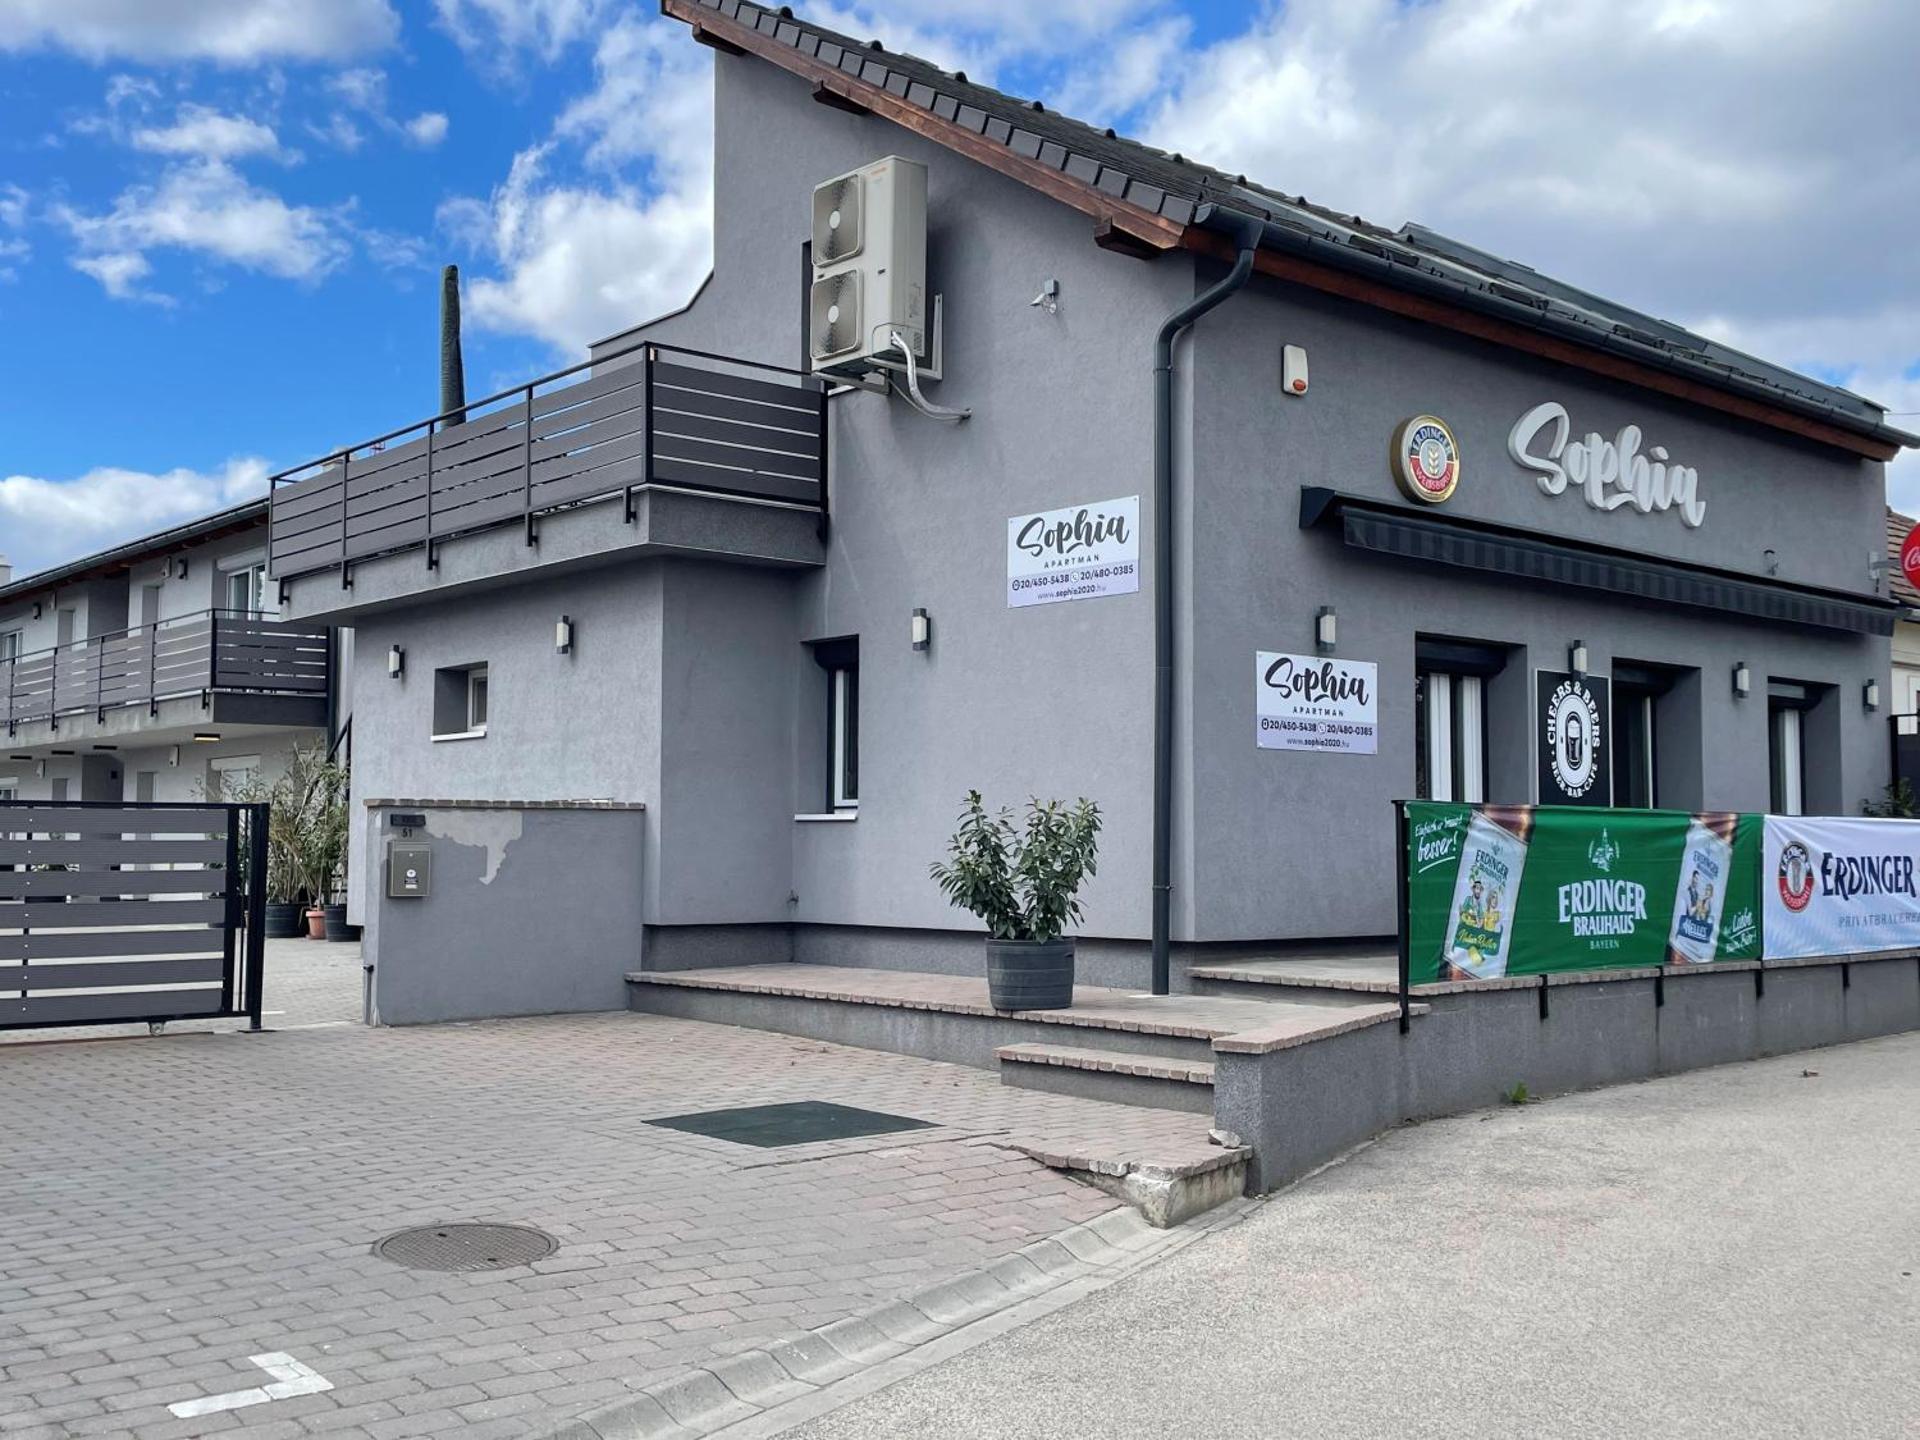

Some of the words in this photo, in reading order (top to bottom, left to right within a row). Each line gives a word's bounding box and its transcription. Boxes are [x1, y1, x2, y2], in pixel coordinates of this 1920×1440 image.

[1508, 401, 1706, 528] Sophia
[1016, 508, 1130, 558] Sophia
[1044, 554, 1100, 569] APARTMAN
[1264, 657, 1369, 706] Sophia
[1293, 706, 1344, 717] APARTMAN
[1547, 680, 1572, 745] CHEERS
[1582, 689, 1601, 748] BEERS
[402, 828, 413, 838] 51
[1418, 830, 1459, 863] besser!
[1475, 849, 1510, 881] ERDINGER
[1820, 852, 1917, 902] ERDINGER
[1558, 878, 1648, 923] ERDINGER
[1573, 914, 1636, 937] BRAUHAUS
[1589, 939, 1620, 951] BAYERN
